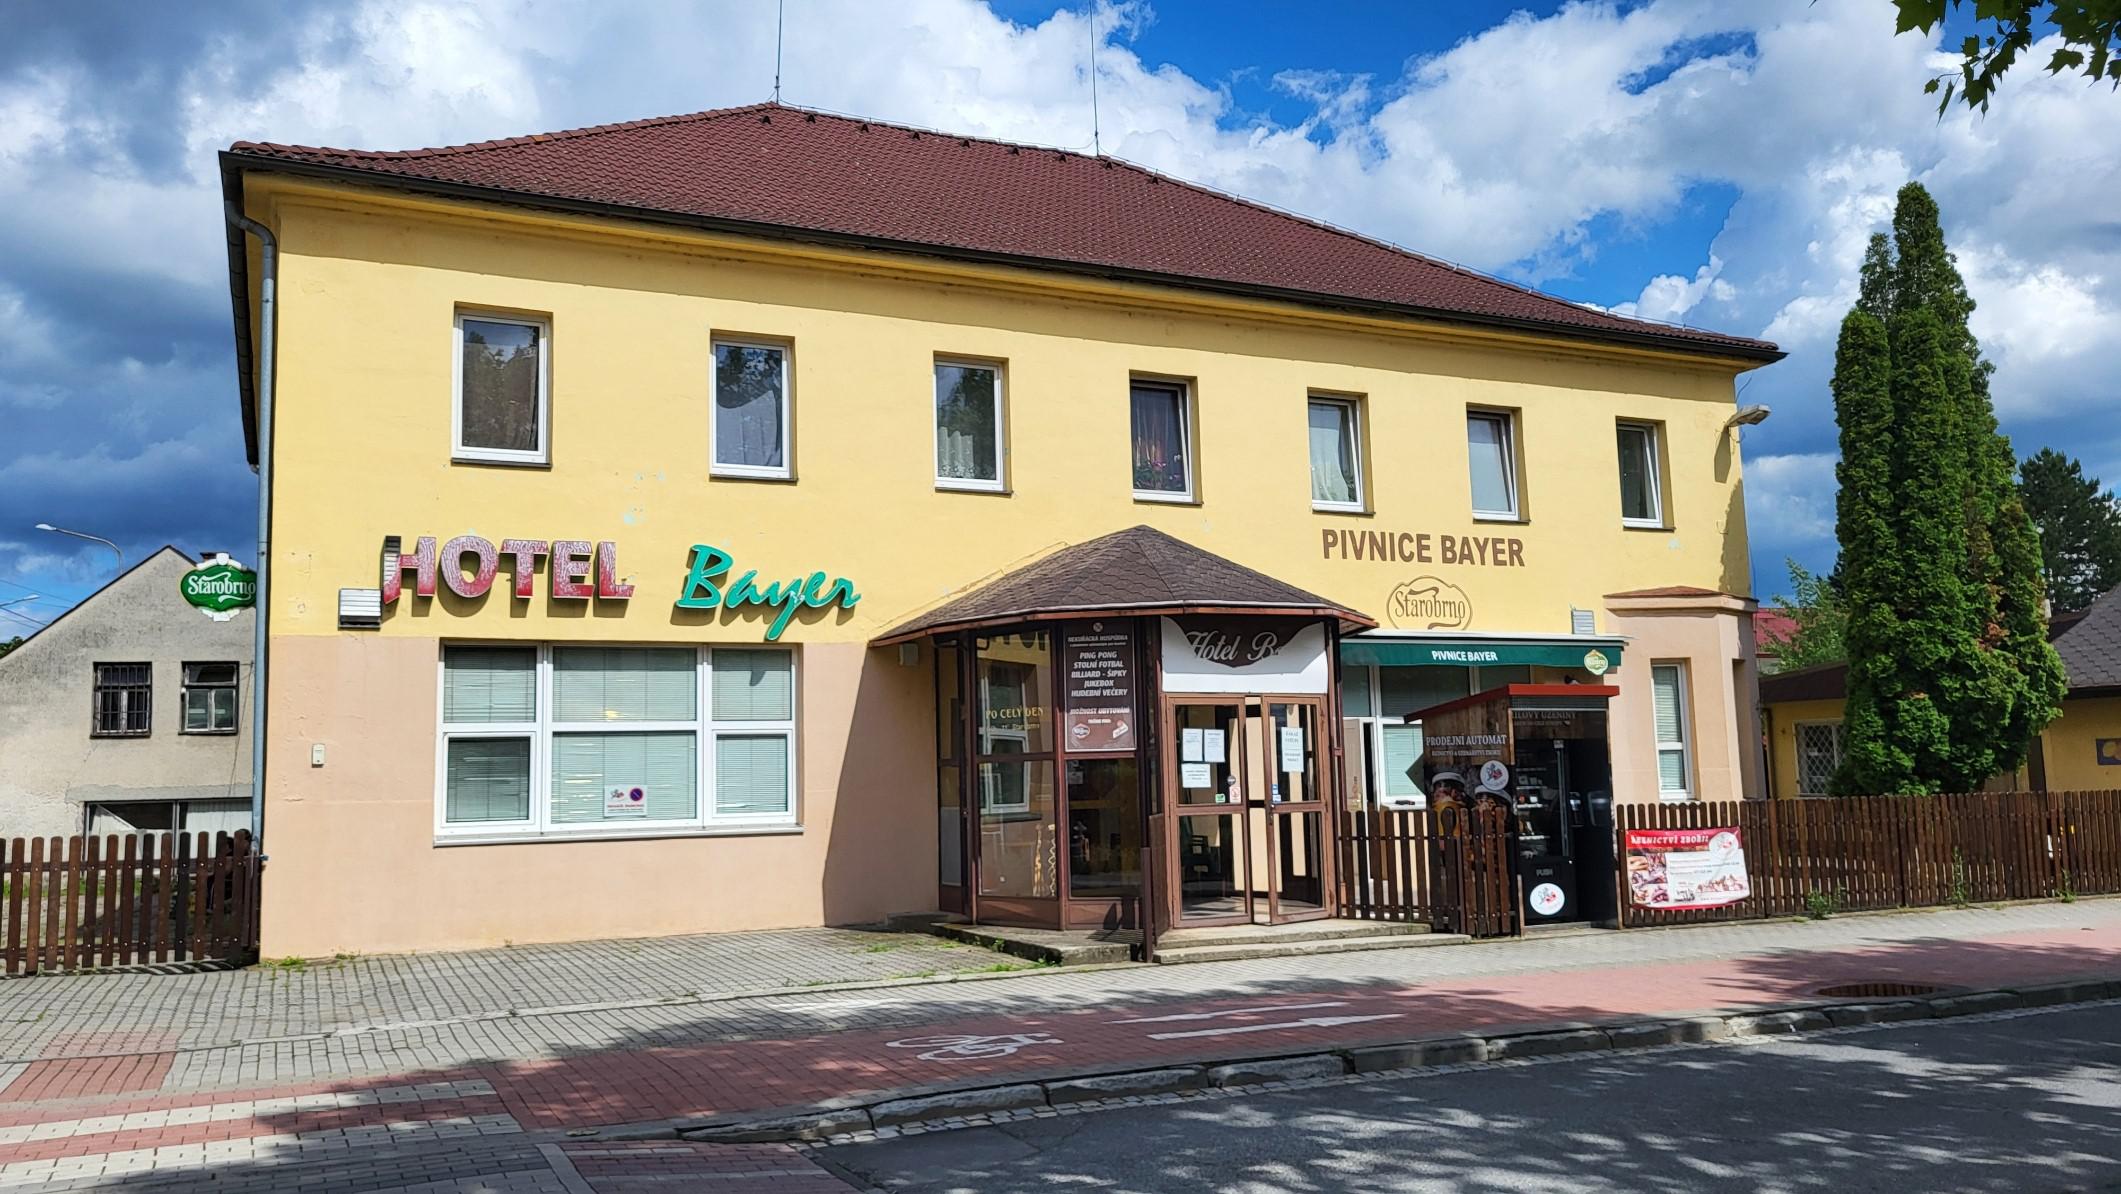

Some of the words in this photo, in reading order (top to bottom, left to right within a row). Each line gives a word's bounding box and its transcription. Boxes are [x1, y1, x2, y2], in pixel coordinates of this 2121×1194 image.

[1322, 529, 1432, 563] PIVNICE
[1440, 535, 1525, 567] BAYER
[383, 536, 635, 604] HOTEL
[188, 572, 256, 602] Starobrno
[676, 544, 861, 641] Bayer
[1395, 587, 1466, 630] Starobrno
[1432, 650, 1467, 661] PIVNICE
[1467, 651, 1498, 662] BAYER
[1073, 660, 1097, 669] STOLNÍ
[1099, 660, 1124, 668] FOTBAL
[1071, 670, 1100, 678] BILLIARD
[1107, 669, 1127, 677] ŠIPKY
[1084, 680, 1114, 688] JUKEBOX
[1071, 688, 1101, 697] HUDEBNÍ
[1103, 688, 1128, 696] VEČERY
[986, 709, 998, 719] PO
[1426, 734, 1465, 746] PRODEJNÍ
[1466, 734, 1508, 746] AUTOMAT
